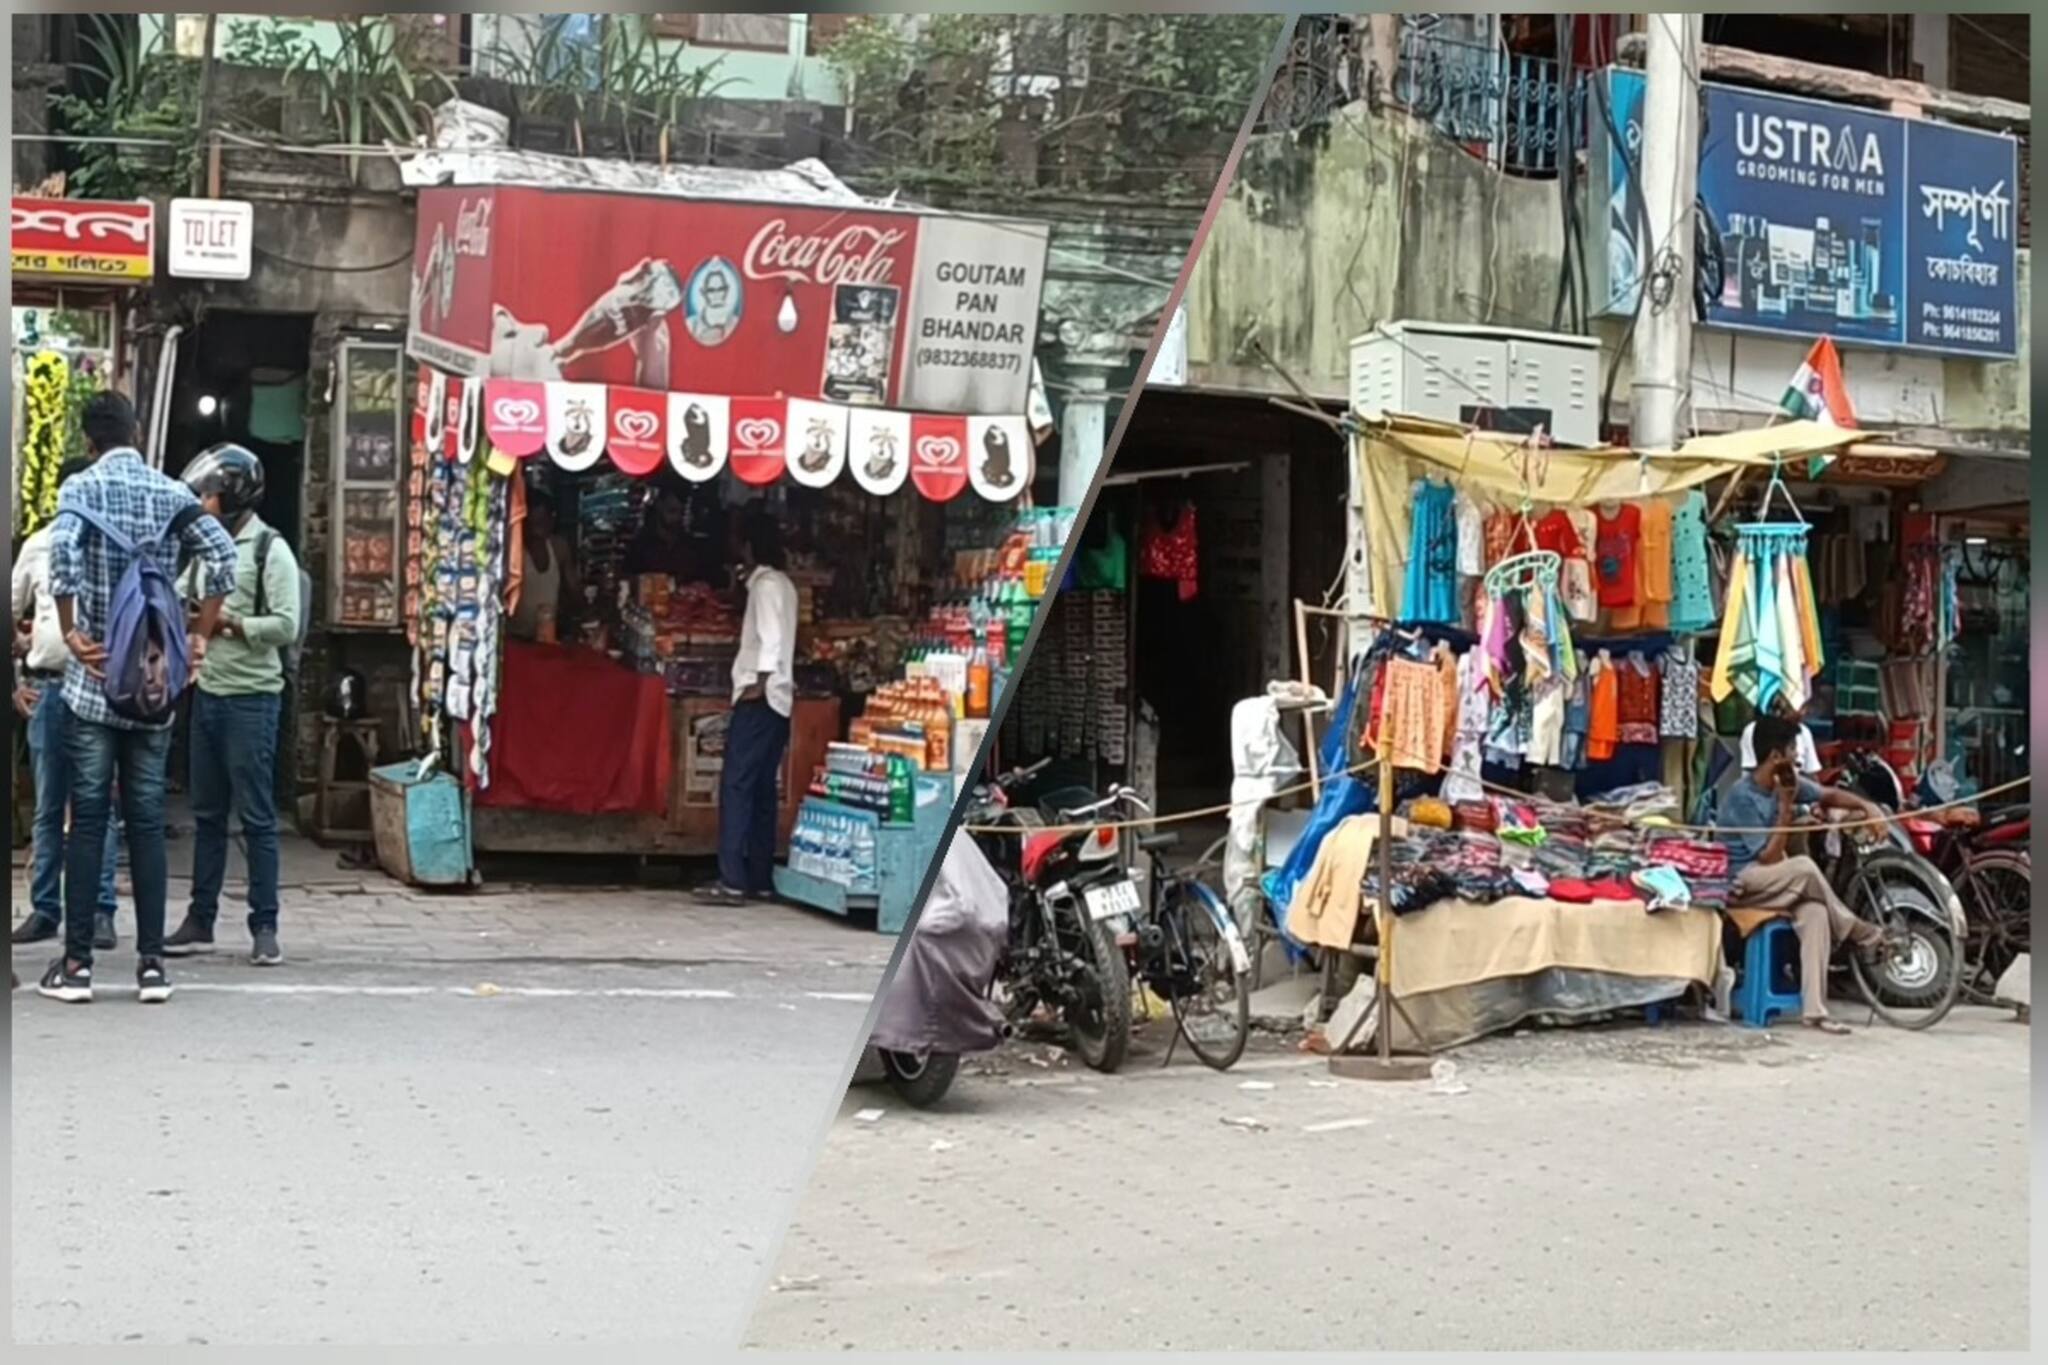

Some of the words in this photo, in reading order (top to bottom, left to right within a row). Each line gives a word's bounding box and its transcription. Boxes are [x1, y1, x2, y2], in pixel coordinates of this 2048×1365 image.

[1735, 111, 1884, 175] USTRAA
[1736, 160, 1817, 186] GROOMING
[1822, 174, 1849, 192] FOR
[1855, 178, 1885, 195] MEN
[1920, 179, 2010, 252] সম্পূর্ণা
[182, 218, 204, 246] TO
[209, 220, 237, 247] LET
[936, 261, 1026, 287] GOUTAM
[956, 291, 999, 314] PAN
[922, 318, 1025, 344] BHANDAR
